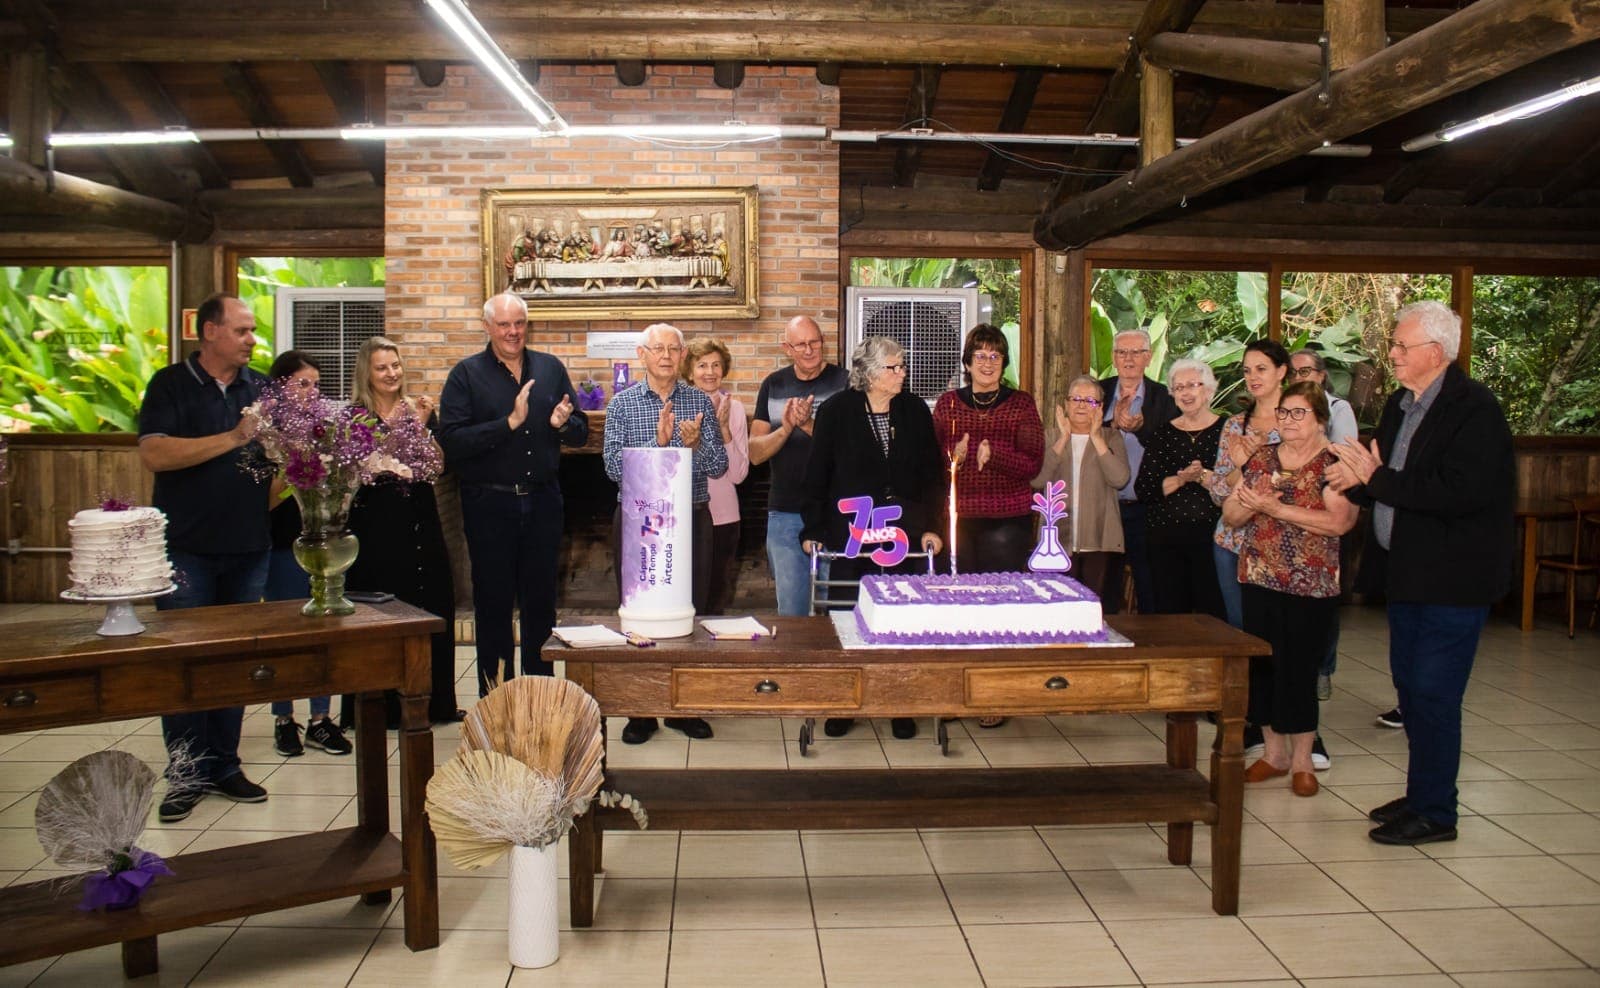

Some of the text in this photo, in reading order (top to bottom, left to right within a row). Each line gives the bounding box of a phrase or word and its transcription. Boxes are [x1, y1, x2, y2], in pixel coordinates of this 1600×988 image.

[641, 515, 664, 536] 75
[837, 495, 910, 567] 75
[861, 528, 897, 543] ANOS
[640, 547, 648, 581] Cápsula
[648, 544, 657, 585] do Tempo
[664, 543, 673, 584] Artecola
